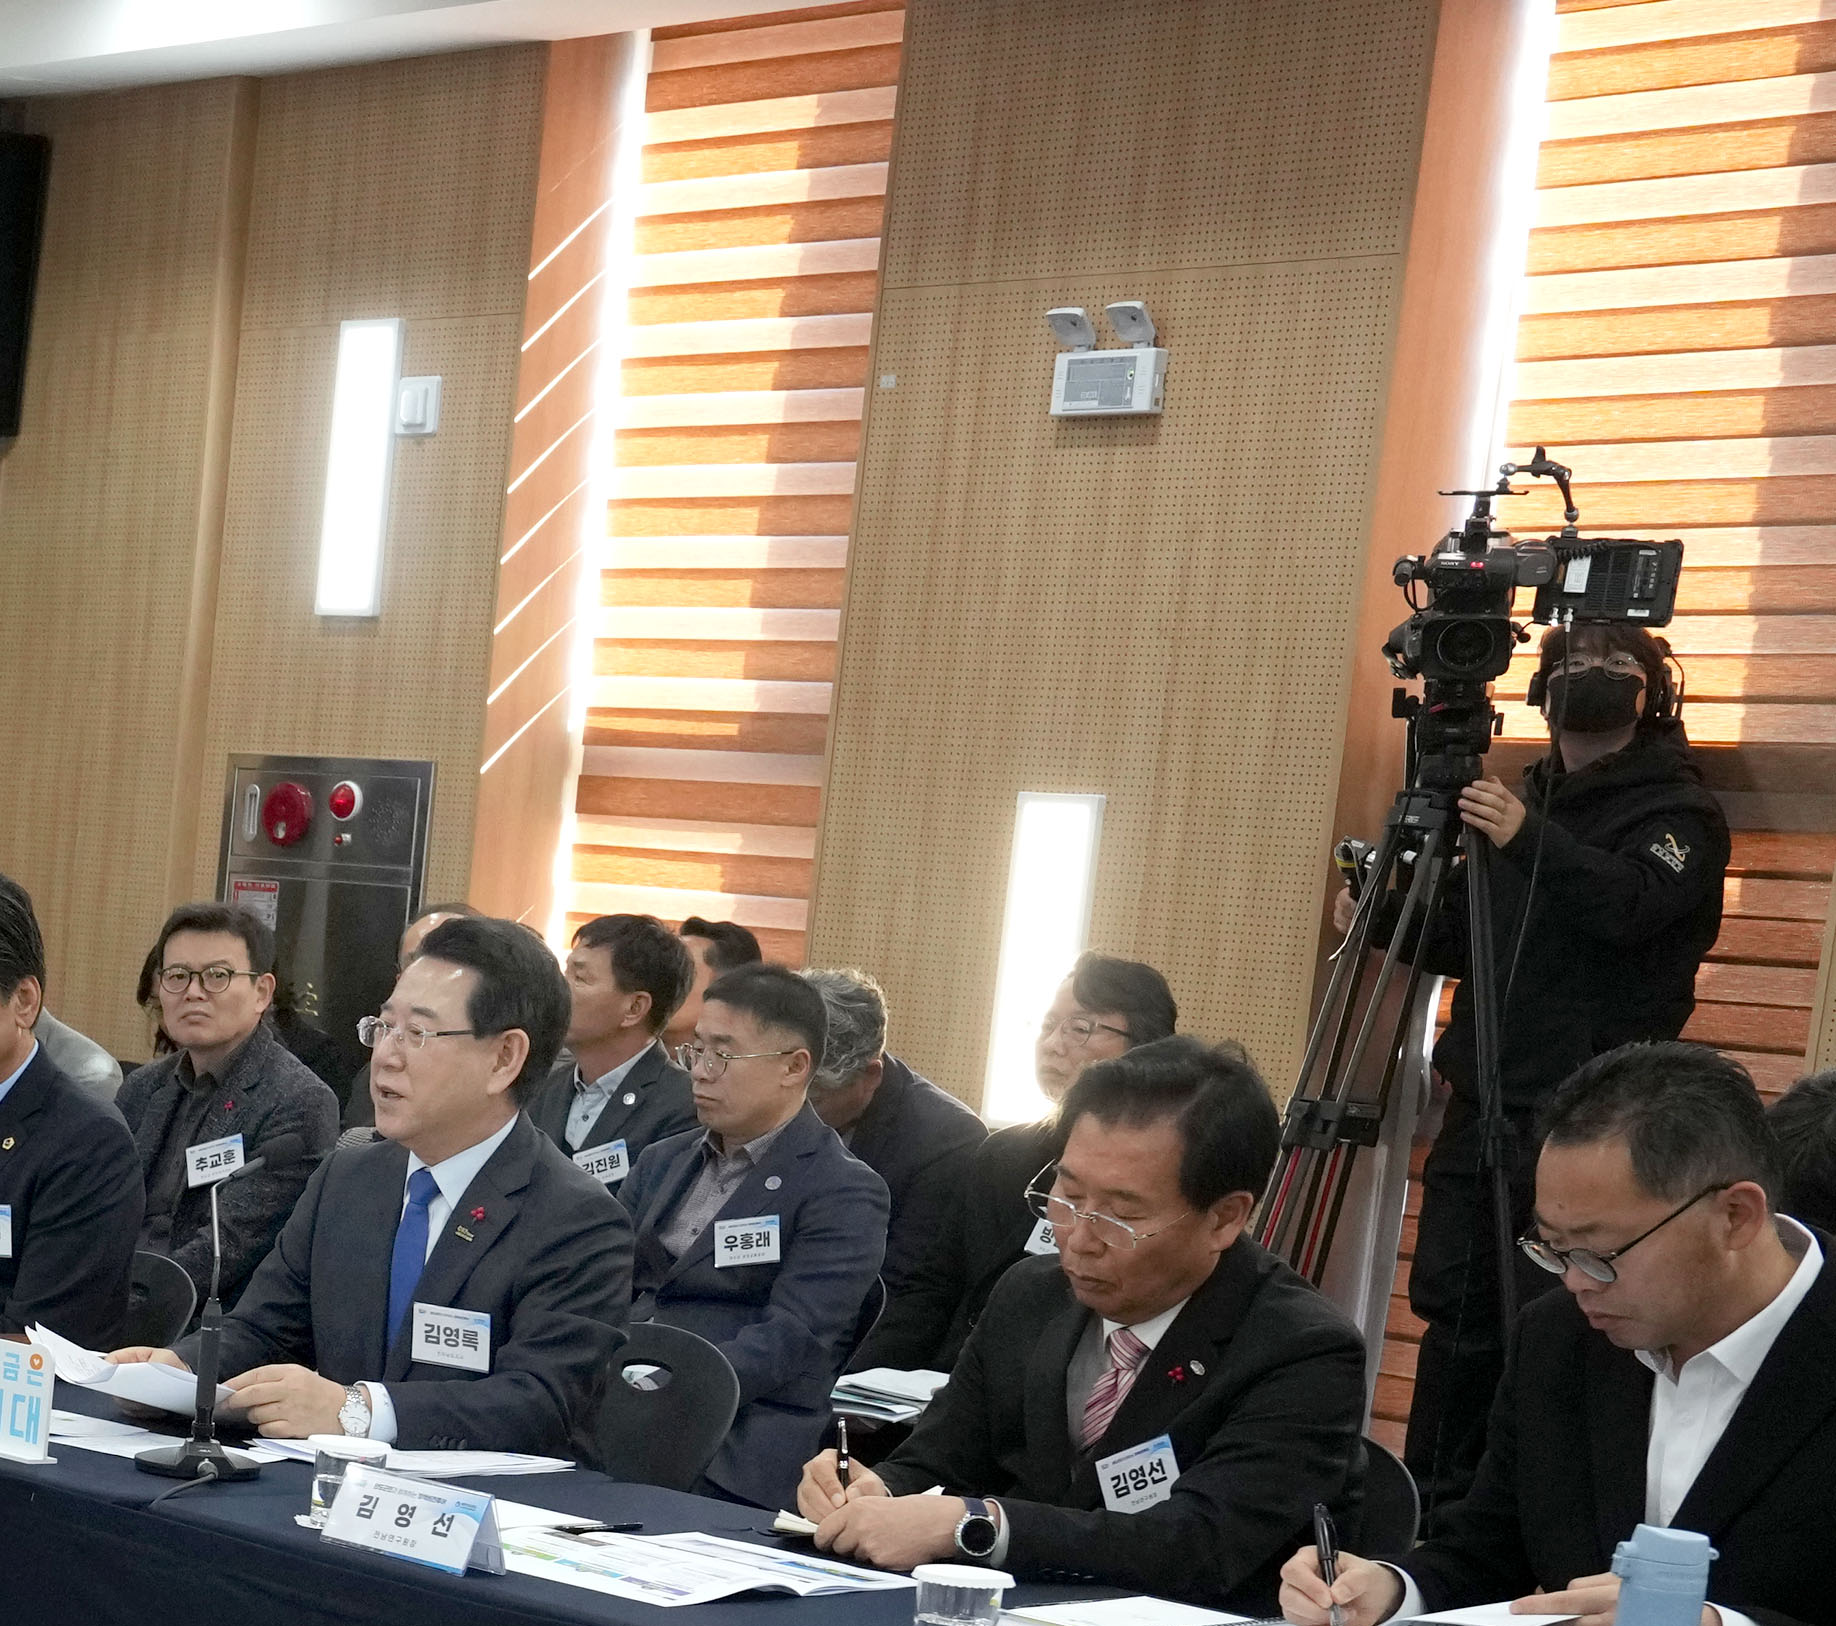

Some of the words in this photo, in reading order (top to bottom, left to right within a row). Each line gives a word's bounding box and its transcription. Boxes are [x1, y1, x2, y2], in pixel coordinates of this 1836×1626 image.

[195, 1149, 236, 1171] 추교훈
[724, 1230, 771, 1252] 우홍래
[423, 1323, 480, 1352] 김영록
[1110, 1457, 1169, 1499] 김영선
